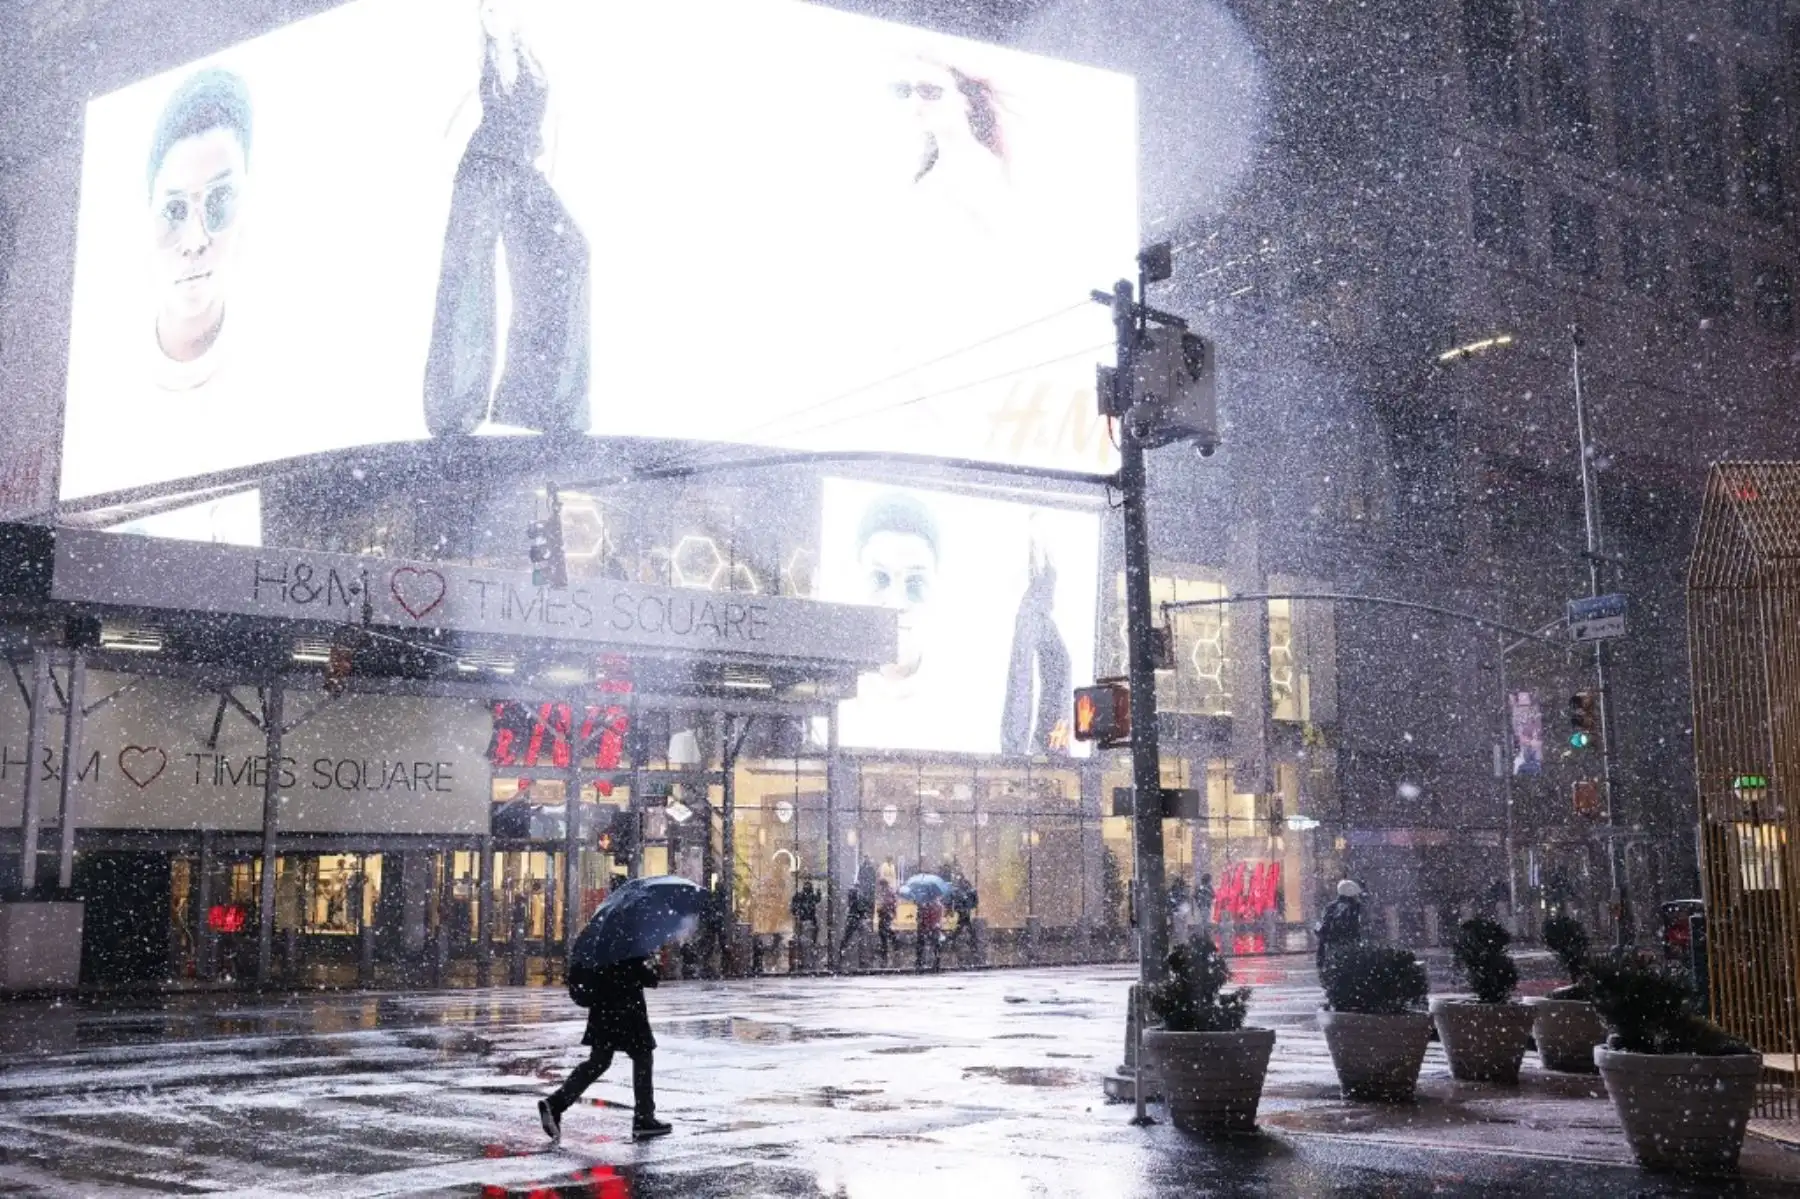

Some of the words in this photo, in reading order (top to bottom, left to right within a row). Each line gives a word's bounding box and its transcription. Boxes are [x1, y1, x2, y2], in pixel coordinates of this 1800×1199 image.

[468, 578, 594, 630] TIMES
[610, 591, 768, 642] SQUARE
[185, 752, 296, 788] TIMES
[311, 757, 454, 792] SQUARE
